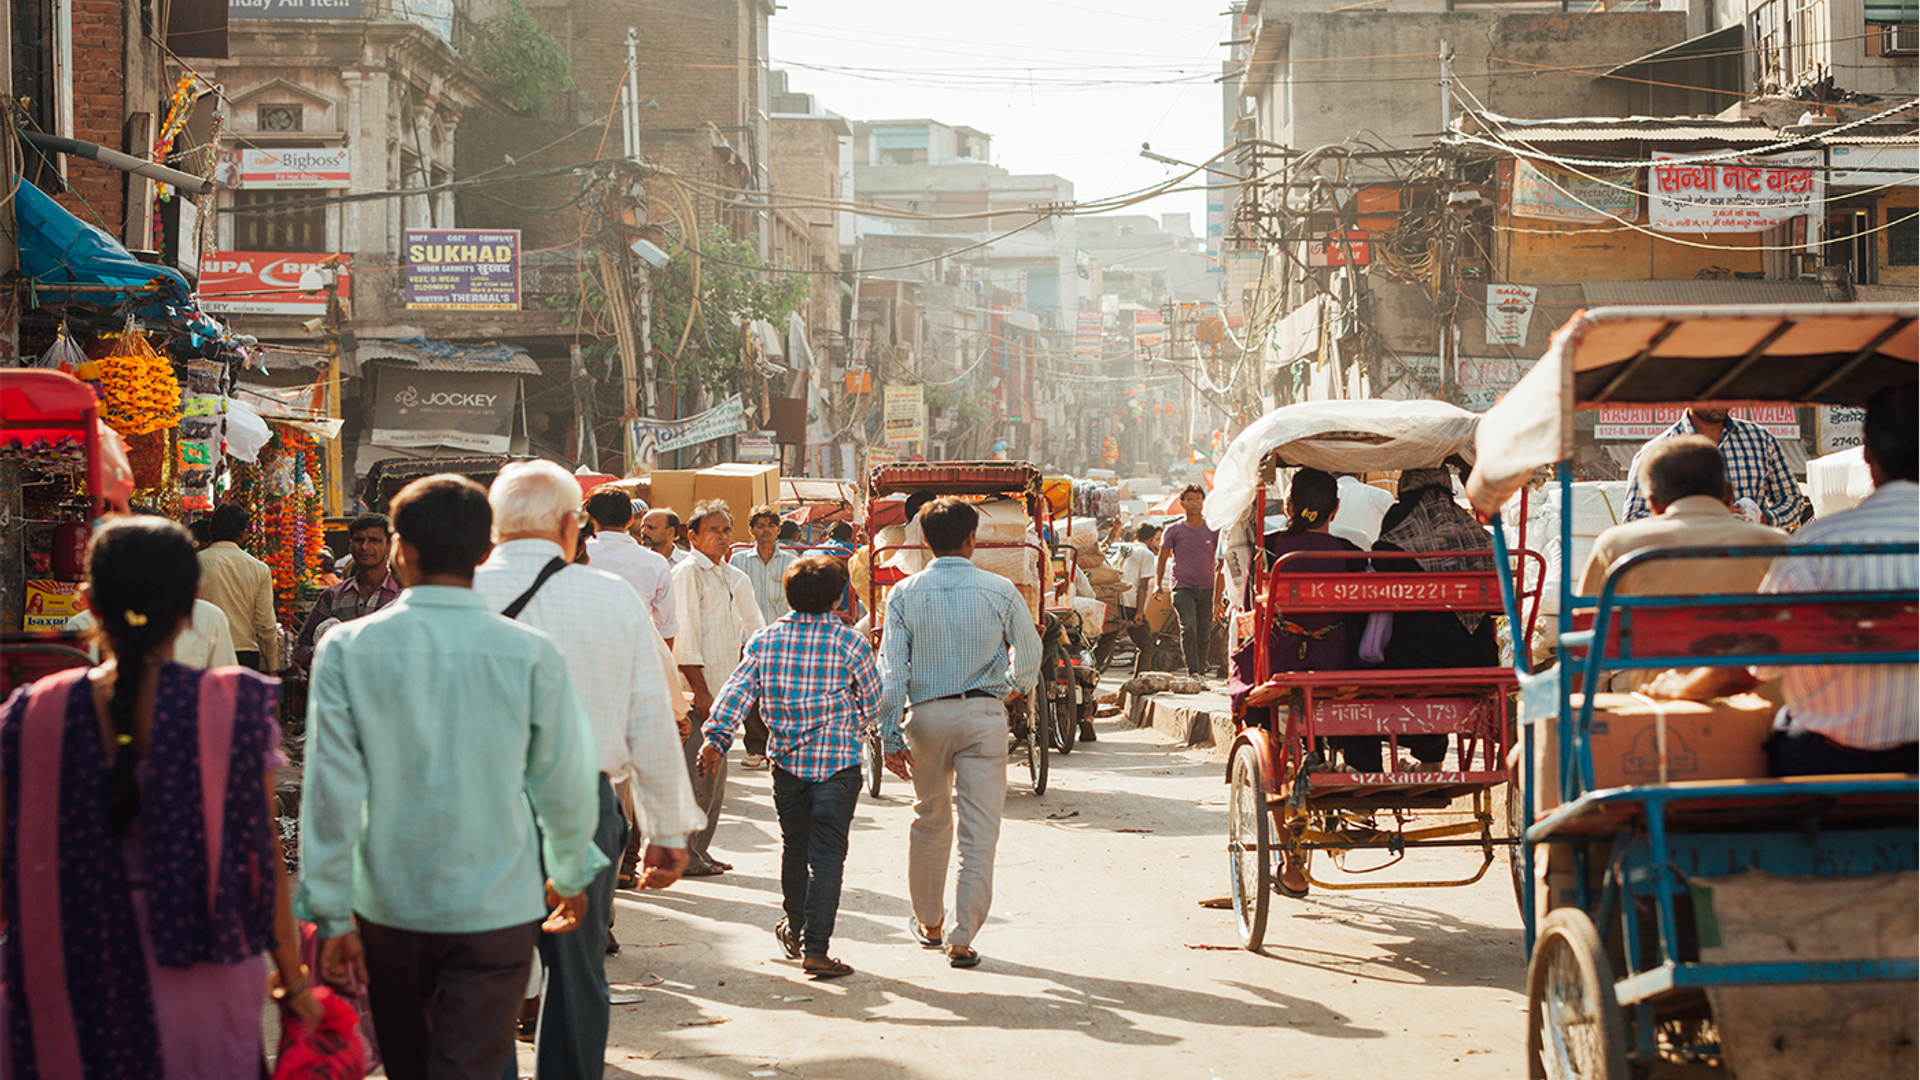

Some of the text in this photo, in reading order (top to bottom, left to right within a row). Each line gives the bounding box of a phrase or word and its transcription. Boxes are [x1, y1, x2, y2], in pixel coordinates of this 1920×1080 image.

[282, 153, 340, 170] Bigboss
[1722, 158, 1763, 193] नोट
[1766, 169, 1814, 193] वाला
[409, 245, 512, 263] SUKHAD
[283, 263, 349, 276] RUA
[451, 293, 510, 302] THERMAL'S
[421, 392, 498, 407] JOCKEY
[1600, 408, 1652, 424] RAJAN
[1751, 406, 1797, 424] WALA
[1628, 427, 1645, 435] MAIN
[1312, 583, 1468, 599] K 9213402221 T
[1426, 704, 1457, 720] 179
[1376, 717, 1410, 732] K T
[1350, 772, 1466, 784] 9213402221
